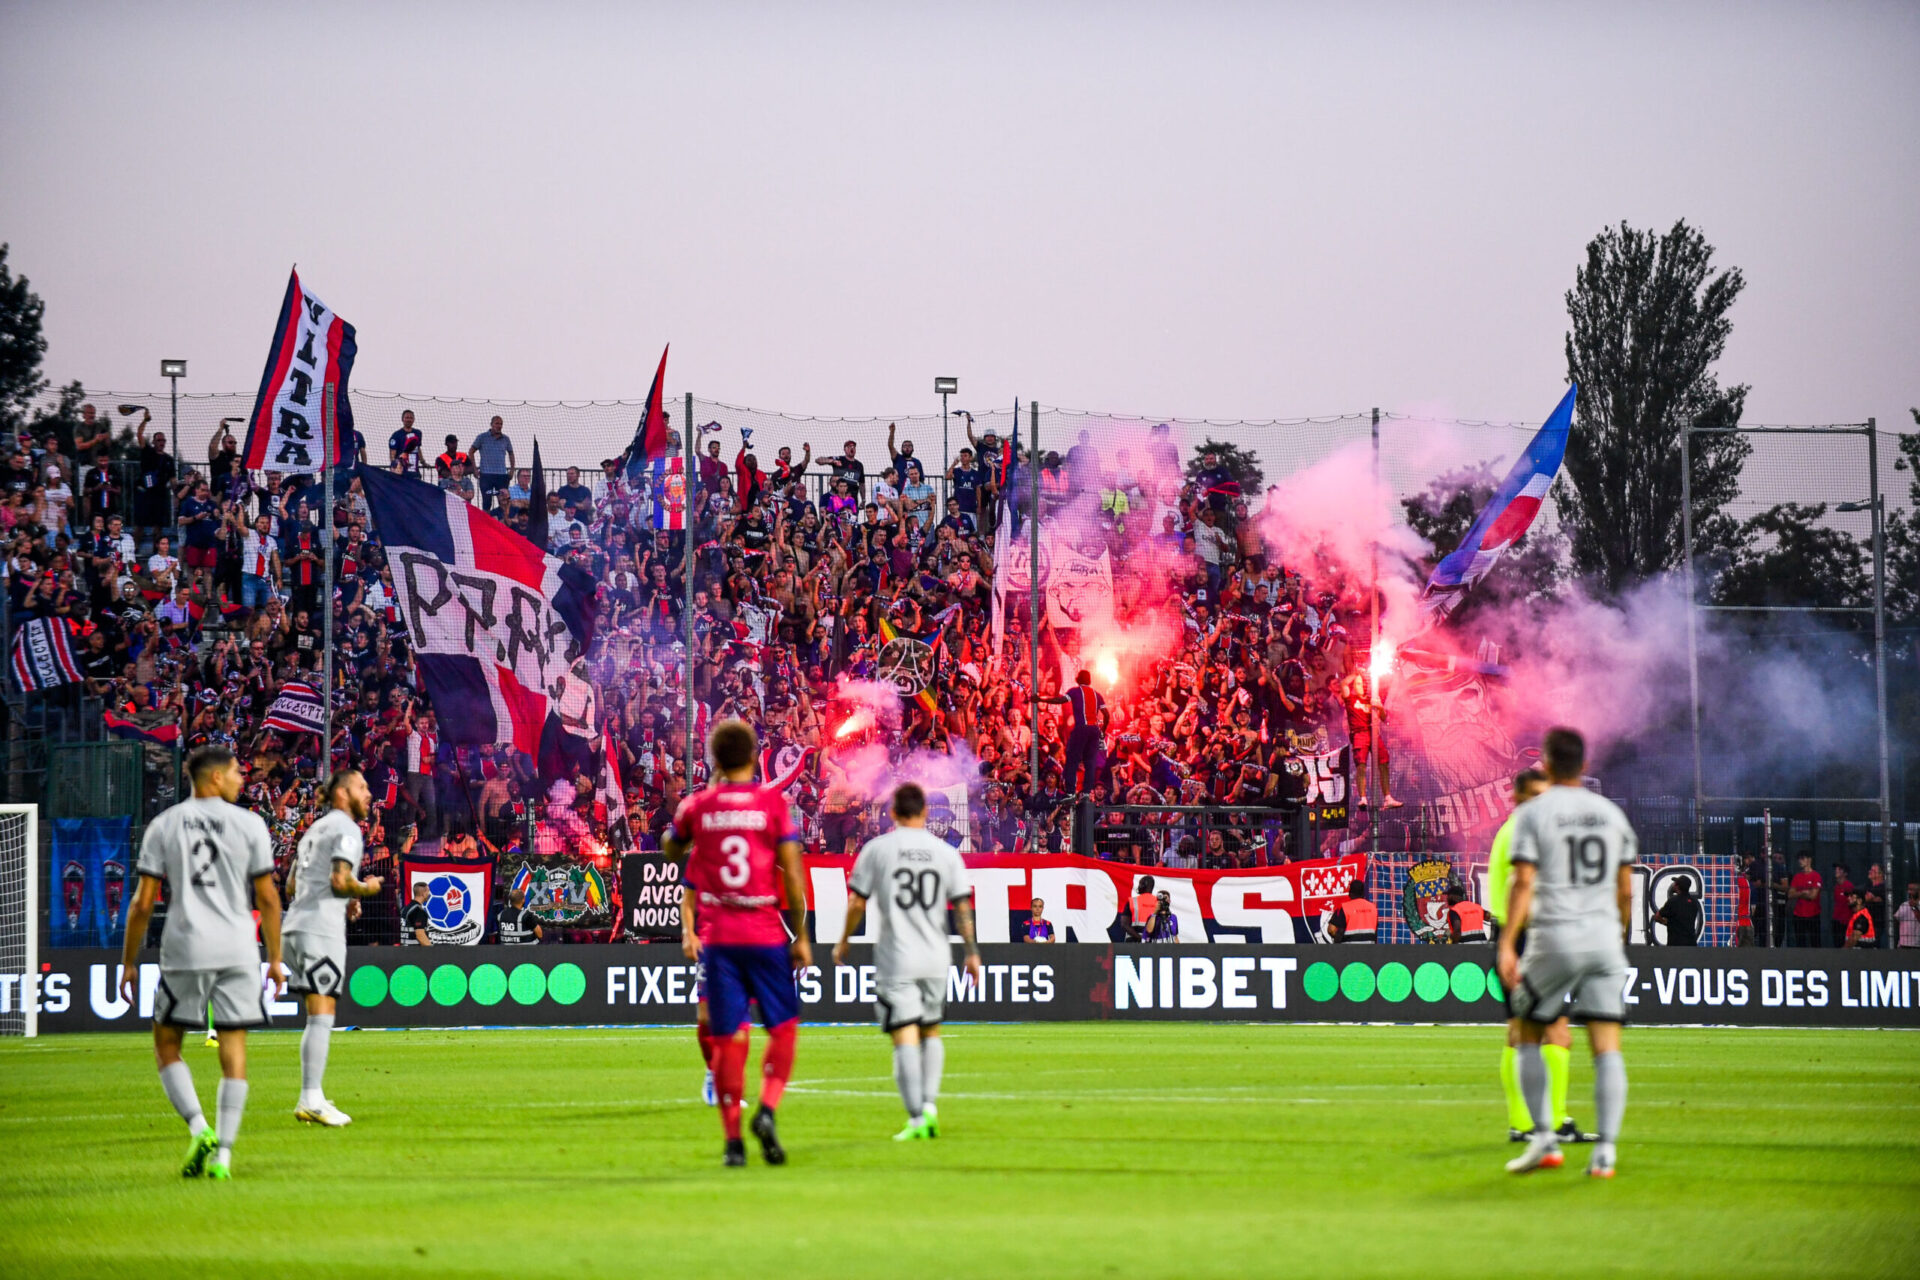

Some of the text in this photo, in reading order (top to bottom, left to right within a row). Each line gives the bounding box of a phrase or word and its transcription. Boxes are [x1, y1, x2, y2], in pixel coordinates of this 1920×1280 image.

[191, 838, 218, 887] 2
[643, 862, 679, 882] DJO
[719, 835, 751, 888] 3
[1565, 834, 1608, 885] 19
[638, 884, 685, 905] AVEC
[893, 867, 941, 911] 30
[633, 906, 680, 927] NOUS
[834, 965, 878, 1003] DE
[947, 965, 1055, 1003] MITES
[1114, 955, 1297, 1009] NIBET
[1761, 969, 1829, 1007] DES
